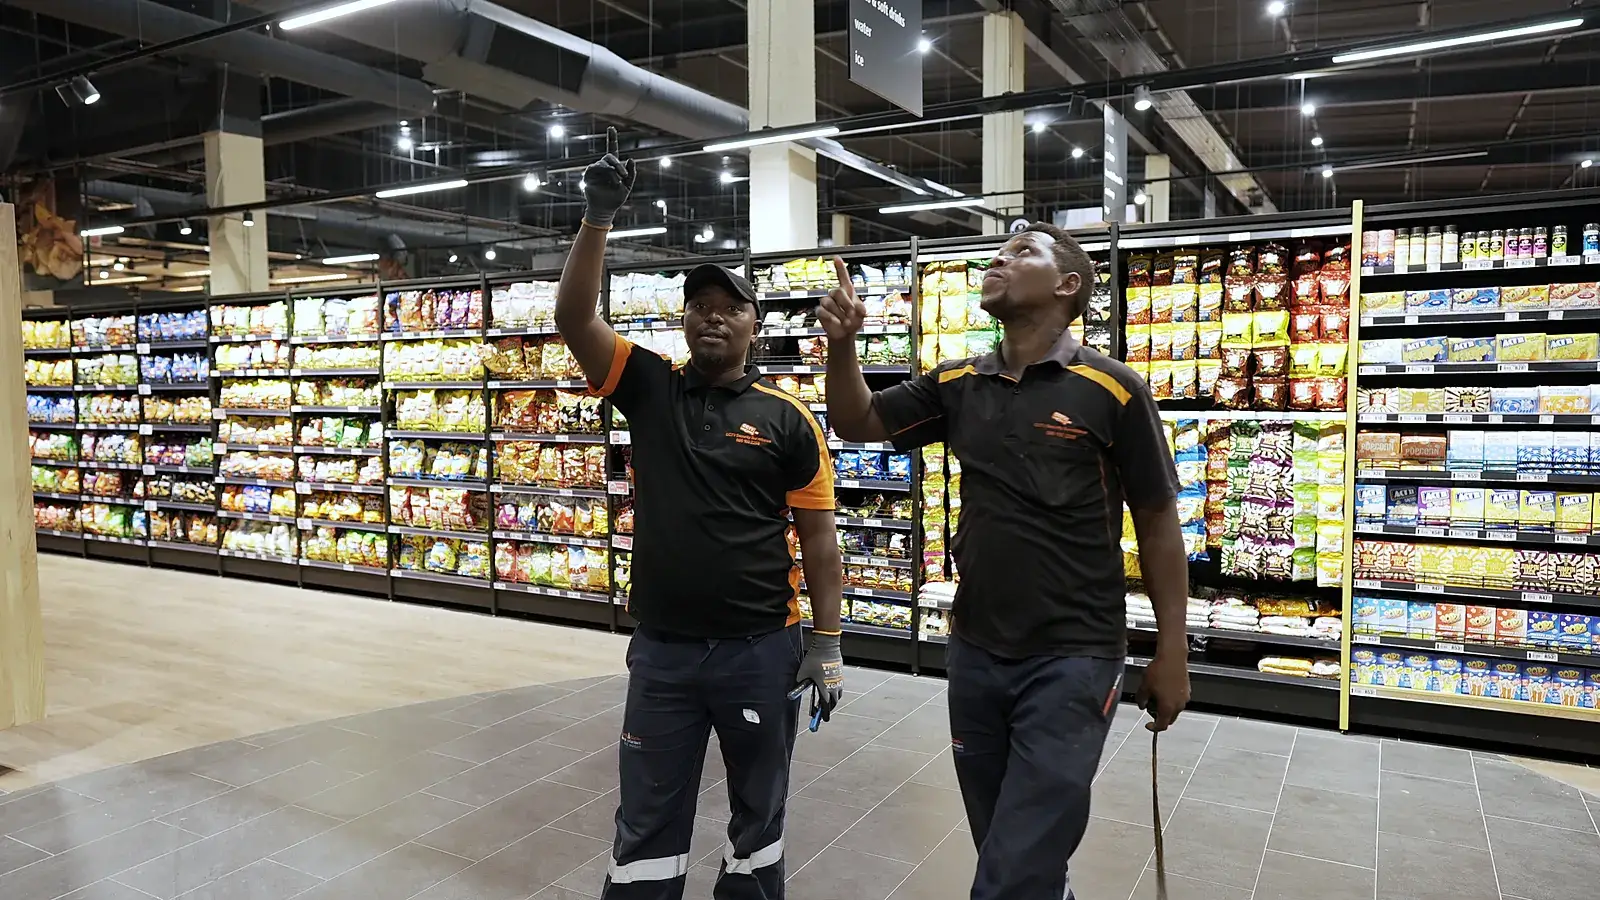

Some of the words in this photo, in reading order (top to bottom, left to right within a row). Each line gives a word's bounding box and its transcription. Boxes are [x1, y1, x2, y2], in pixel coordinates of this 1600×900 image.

[877, 1, 889, 16] soft
[889, 6, 906, 28] drinks
[854, 18, 873, 38] water
[855, 50, 865, 67] ice
[1361, 441, 1394, 452] POPCORN
[1405, 447, 1440, 456] POPCORN
